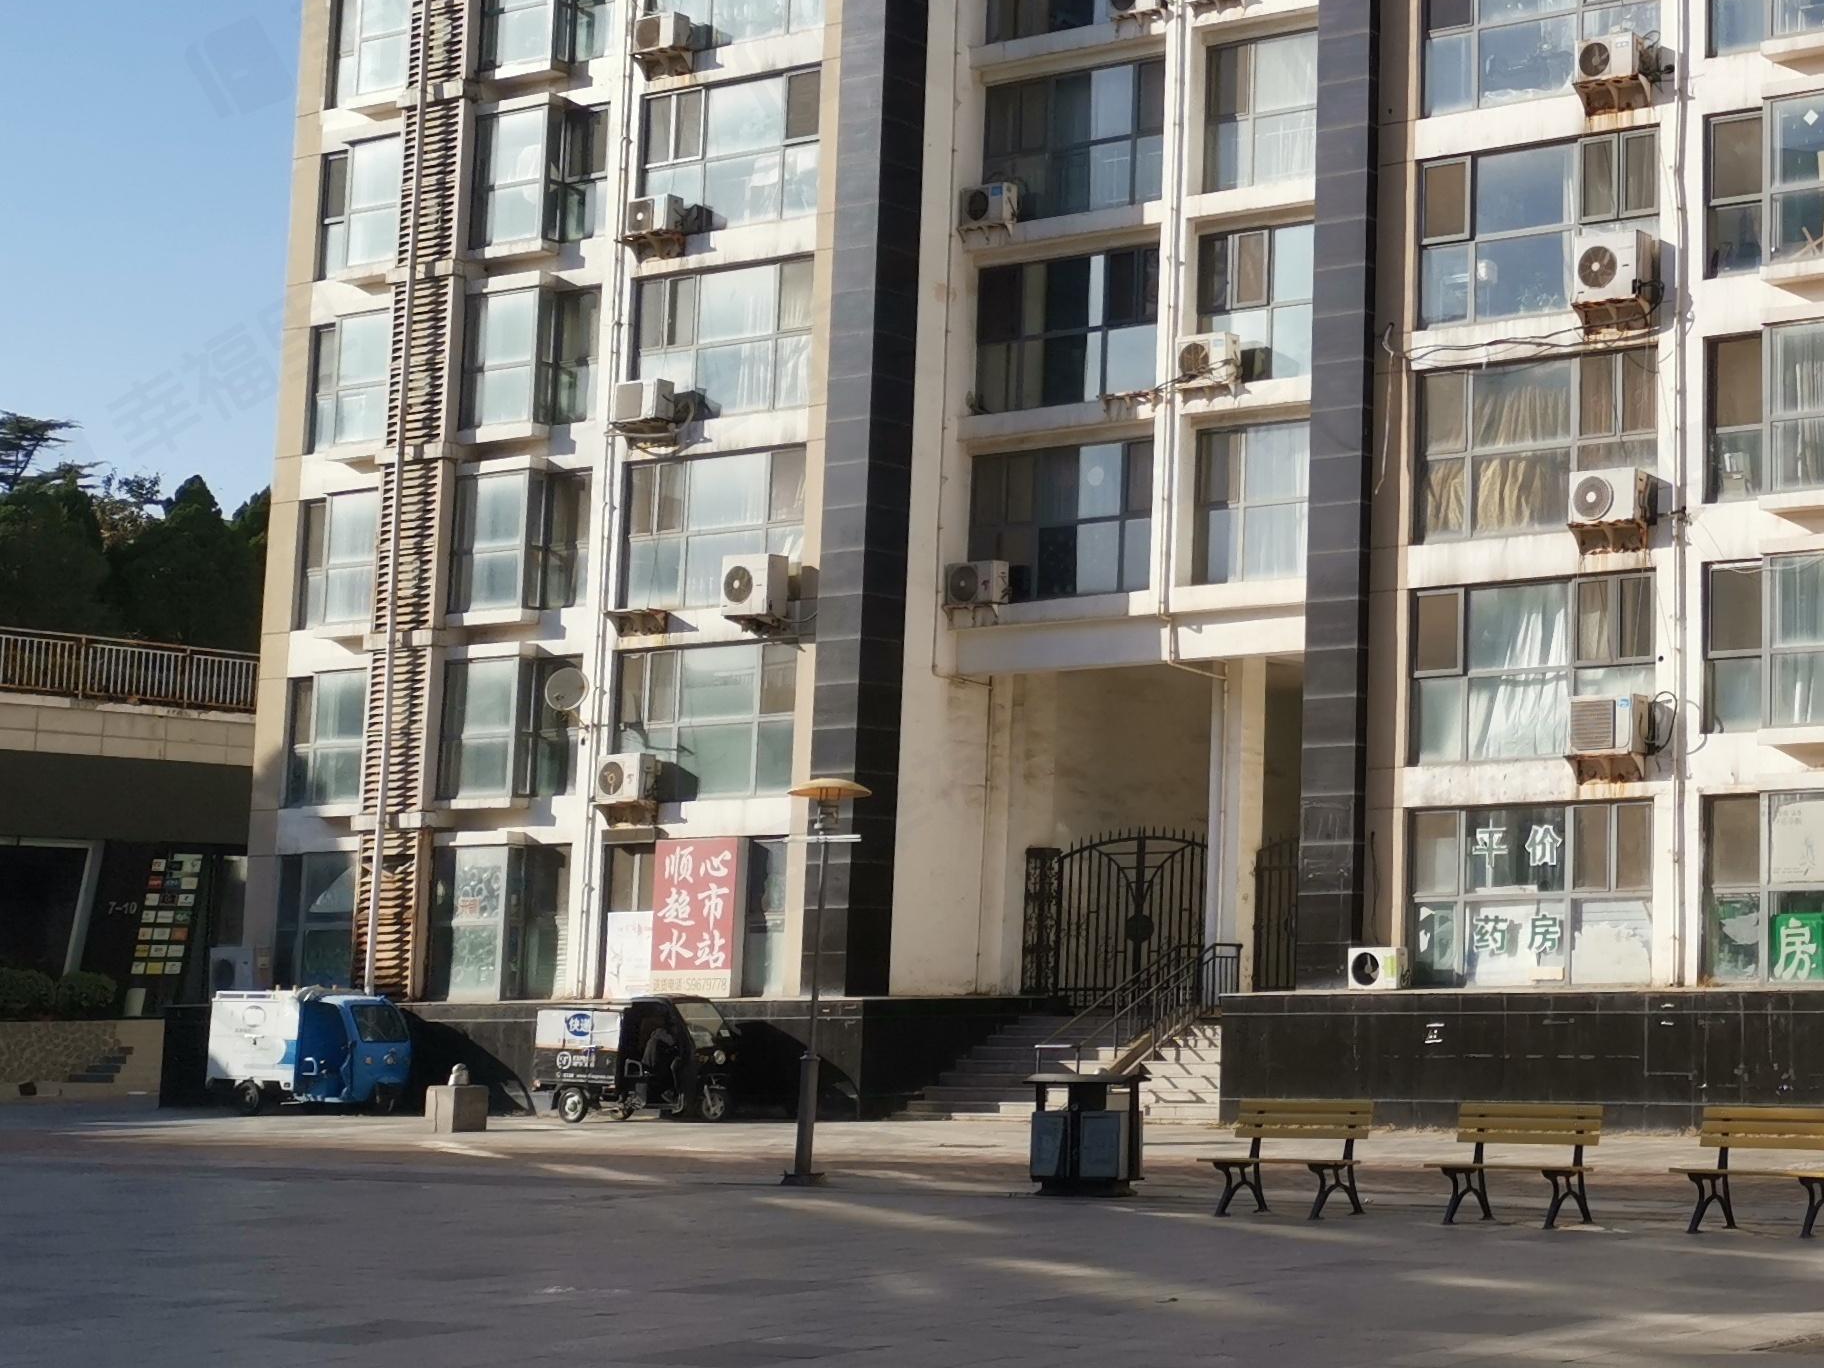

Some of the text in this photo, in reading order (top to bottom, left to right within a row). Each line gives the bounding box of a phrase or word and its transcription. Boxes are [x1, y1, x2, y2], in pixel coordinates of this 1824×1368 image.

[664, 845, 733, 885] 顺心
[1472, 824, 1563, 868] 平价
[657, 882, 730, 931] 超市
[658, 928, 726, 969] 水站
[1473, 912, 1562, 954] 药房
